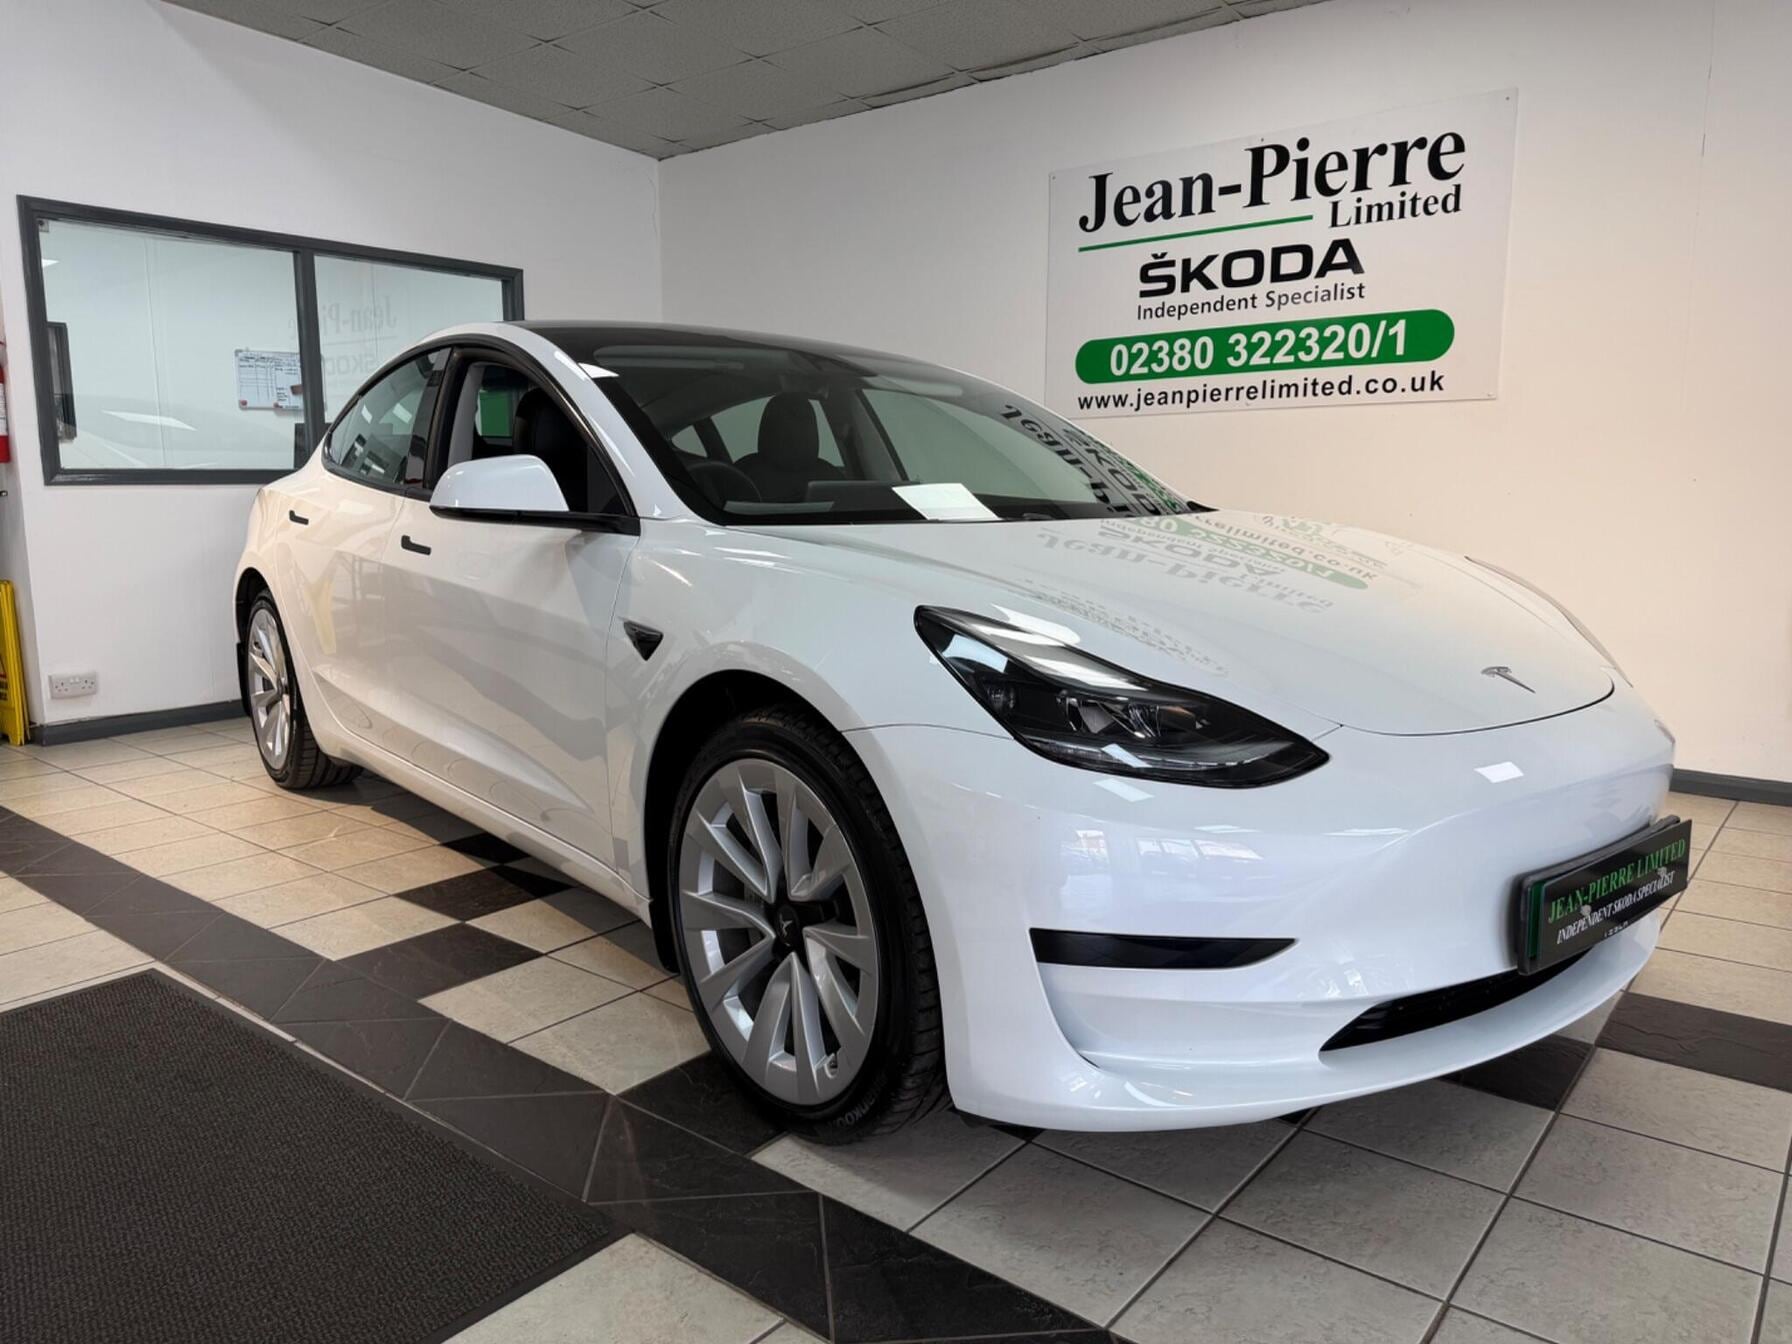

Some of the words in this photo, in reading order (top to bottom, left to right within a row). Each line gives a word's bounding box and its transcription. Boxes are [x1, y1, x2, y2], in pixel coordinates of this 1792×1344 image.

[1078, 130, 1466, 233] Jean-Pierre
[1327, 184, 1462, 228] Limited
[1138, 237, 1365, 298] ŠKODA
[1137, 292, 1258, 321] Independent
[1265, 282, 1366, 311] Specialist
[1110, 335, 1214, 376] 02380
[1226, 319, 1408, 367] 322320/1
[1077, 370, 1445, 411] www.jeanpierrelimited.co.uk
[1548, 862, 1635, 924] JEAN-PIERRE
[1637, 838, 1686, 878] LIMITED
